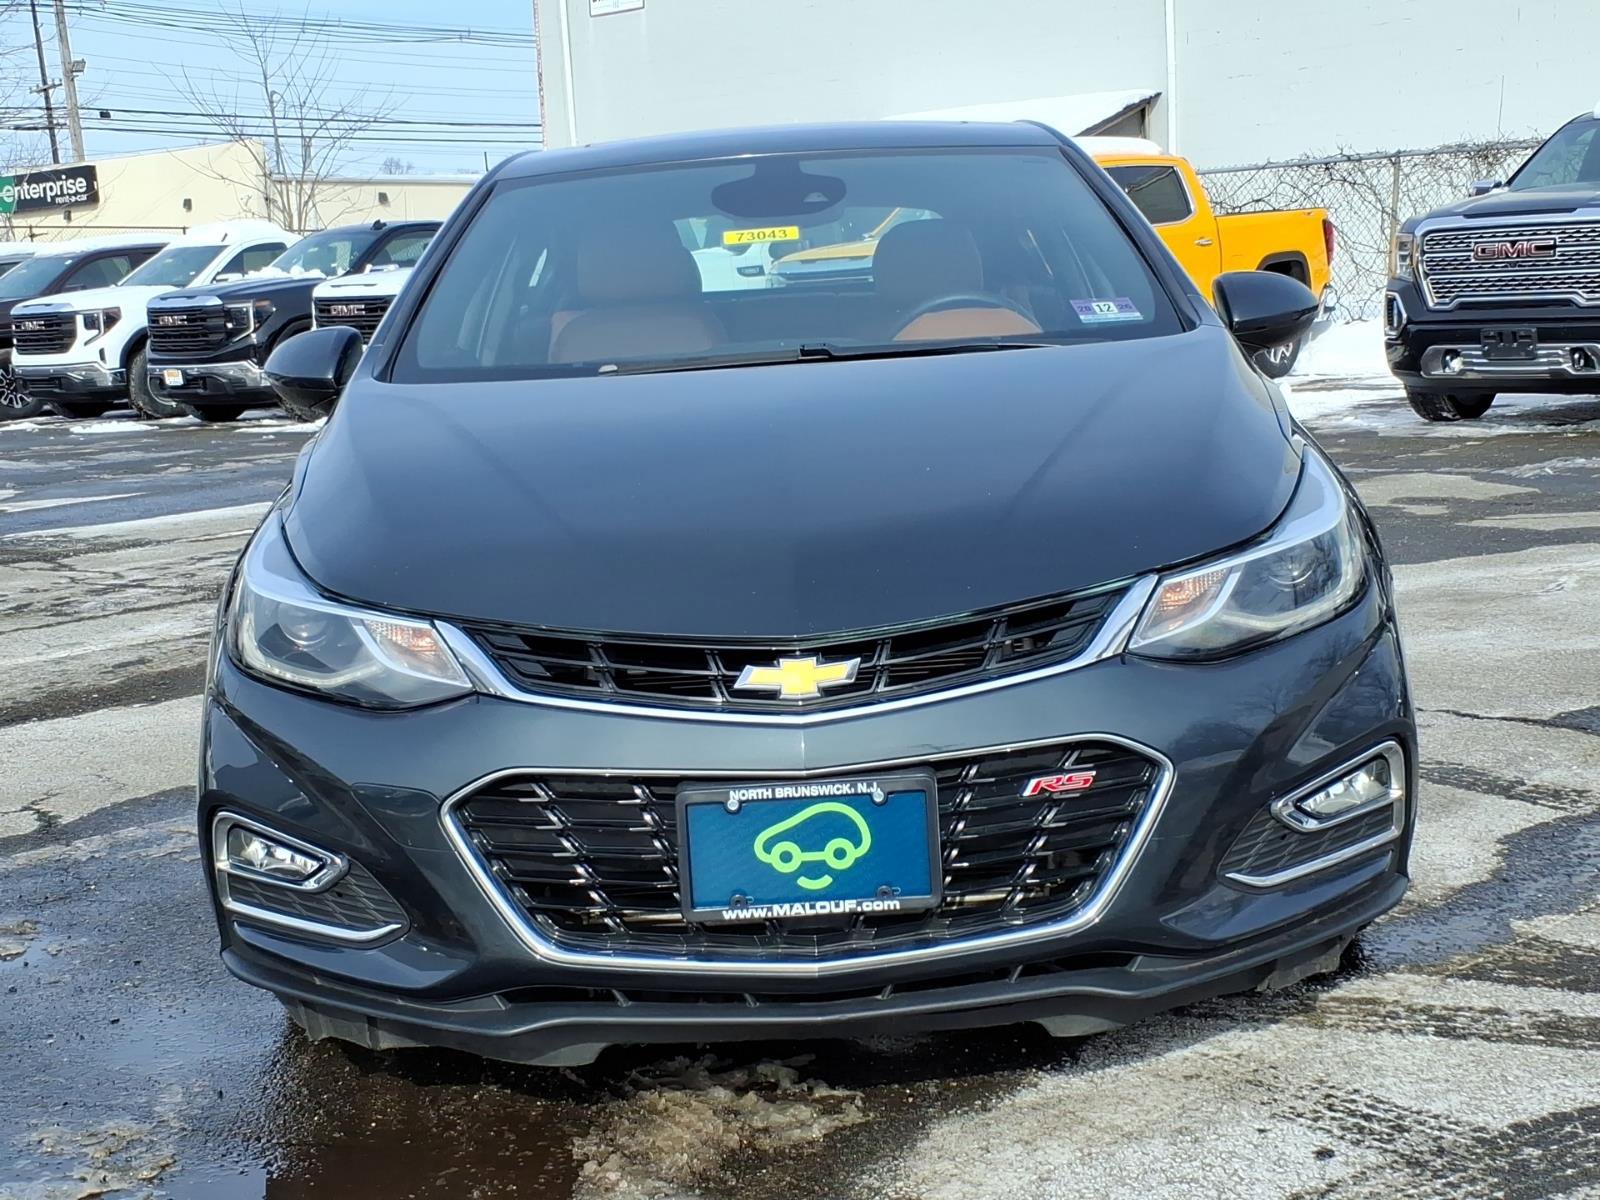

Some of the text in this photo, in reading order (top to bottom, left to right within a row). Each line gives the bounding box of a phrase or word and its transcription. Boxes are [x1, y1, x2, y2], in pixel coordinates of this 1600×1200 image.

[2, 174, 87, 203] enterprise
[55, 194, 87, 205] rent-a-car
[736, 229, 788, 242] 73043
[1474, 240, 1555, 259] GMC
[331, 304, 366, 316] GMC
[1096, 303, 1113, 313] 12
[21, 320, 46, 330] GMC
[159, 315, 188, 326] GMC
[1022, 771, 1096, 797] RS
[729, 788, 772, 801] NORTH
[722, 899, 901, 921] www.MALOUF.com
